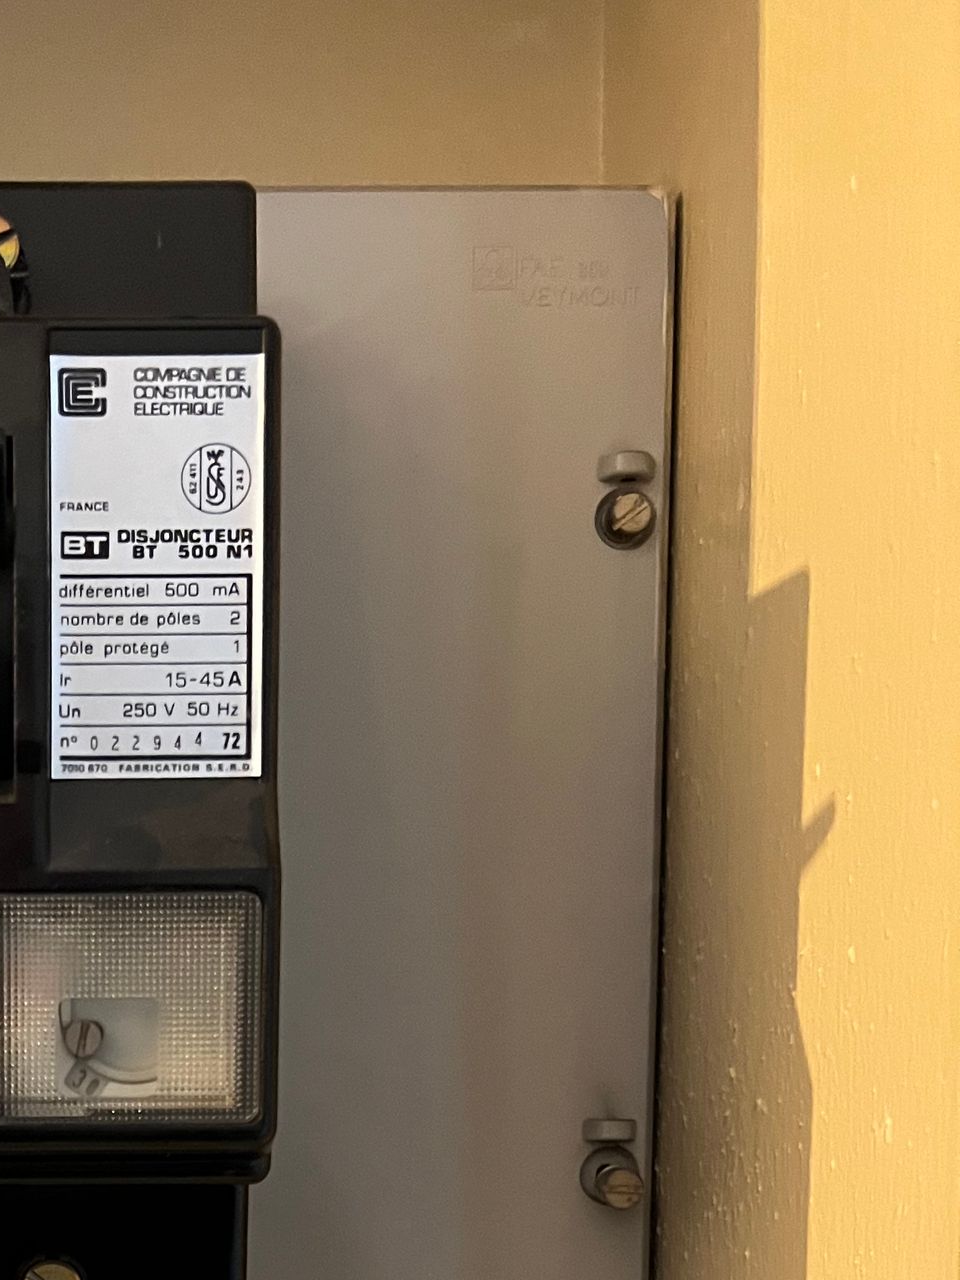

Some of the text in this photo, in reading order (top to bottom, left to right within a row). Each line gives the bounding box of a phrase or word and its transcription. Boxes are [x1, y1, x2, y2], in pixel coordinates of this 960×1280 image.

[133, 367, 246, 382] COMPAGNIE DE
[133, 385, 252, 399] CONSTRUCTION
[133, 402, 224, 416] ELECTRIQUE
[59, 501, 110, 512] FRANCE
[117, 529, 253, 543] DISJONCTEUR
[63, 535, 108, 555] BT
[132, 545, 253, 559] BT 500 N1
[164, 583, 200, 597] 500
[212, 583, 240, 596] mA
[60, 611, 240, 629] nombre de pôles 2
[59, 640, 240, 658] pôle protégé 1
[59, 674, 72, 687] Ir
[58, 702, 239, 718] Un 250 V 50 Hz
[118, 763, 200, 773] FABRICATION
